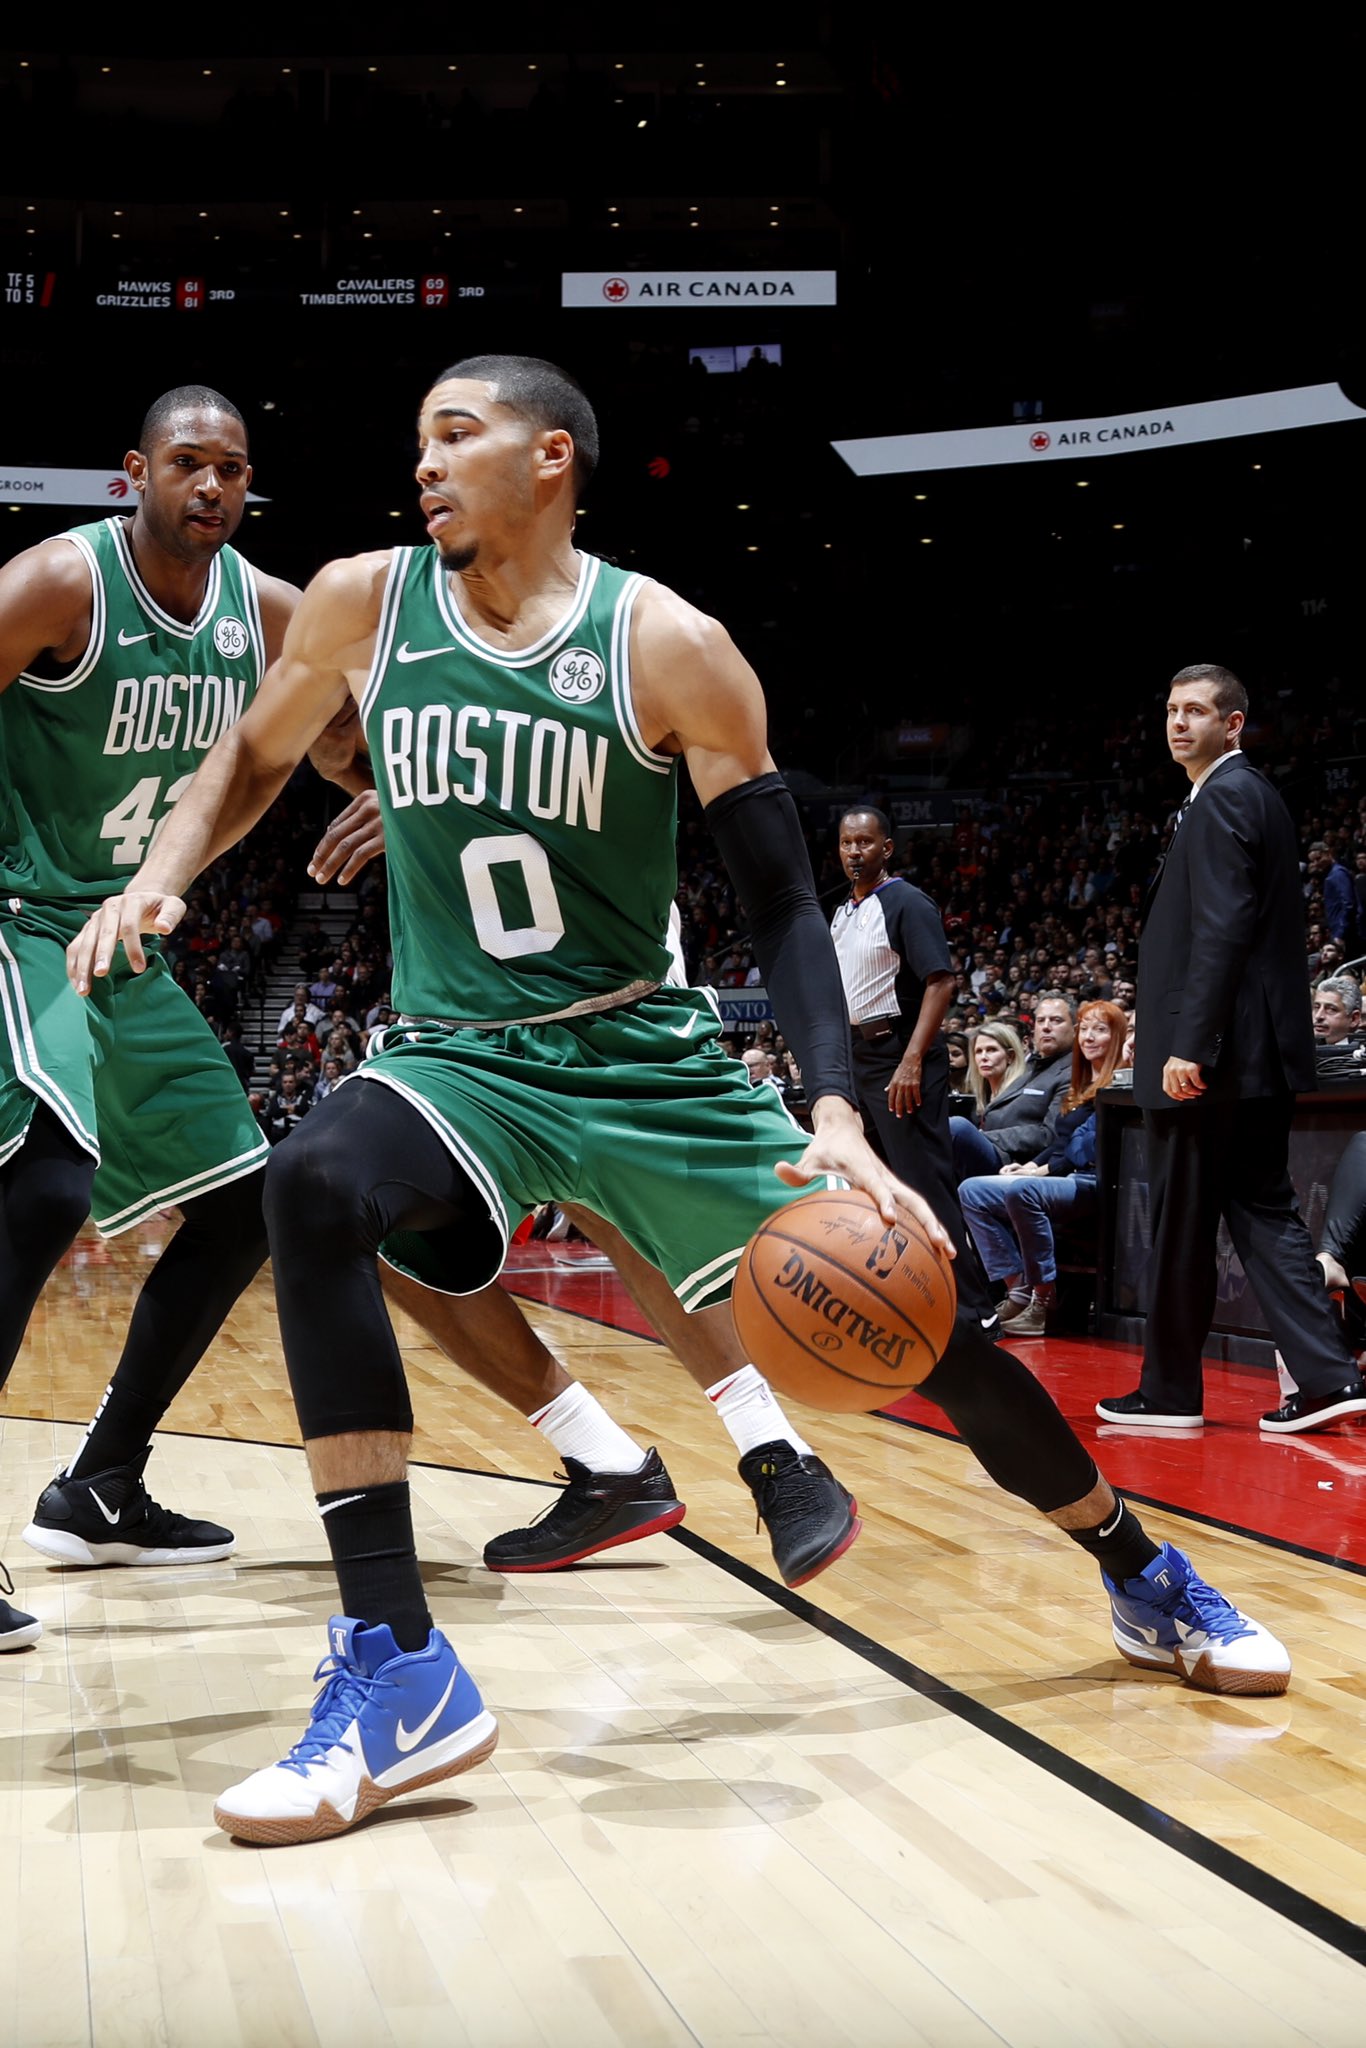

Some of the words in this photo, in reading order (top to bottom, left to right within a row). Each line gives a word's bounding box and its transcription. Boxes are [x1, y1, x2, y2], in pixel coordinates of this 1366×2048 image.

[7, 272, 23, 288] TF
[26, 274, 35, 288] 5
[118, 280, 172, 293] HAWKS
[184, 281, 198, 293] 61
[336, 279, 416, 290] CAVALIERS
[425, 278, 444, 290] 69
[5, 288, 22, 303] TO
[25, 289, 34, 304] 5
[209, 289, 236, 300] 3RD
[458, 286, 485, 298] 3RD
[638, 282, 681, 297] AIR
[689, 281, 795, 297] CANADA
[96, 294, 172, 308] GRIZZLIES
[184, 296, 198, 308] 81
[300, 292, 416, 305] TIMBERWOLVES
[425, 293, 444, 305] 87
[1058, 431, 1091, 446] AIR
[1096, 420, 1175, 443] CANADA
[103, 674, 246, 755] BOSTON
[382, 703, 609, 833] BOSTON
[459, 832, 566, 961] 0
[773, 1252, 916, 1371] SPALDING
